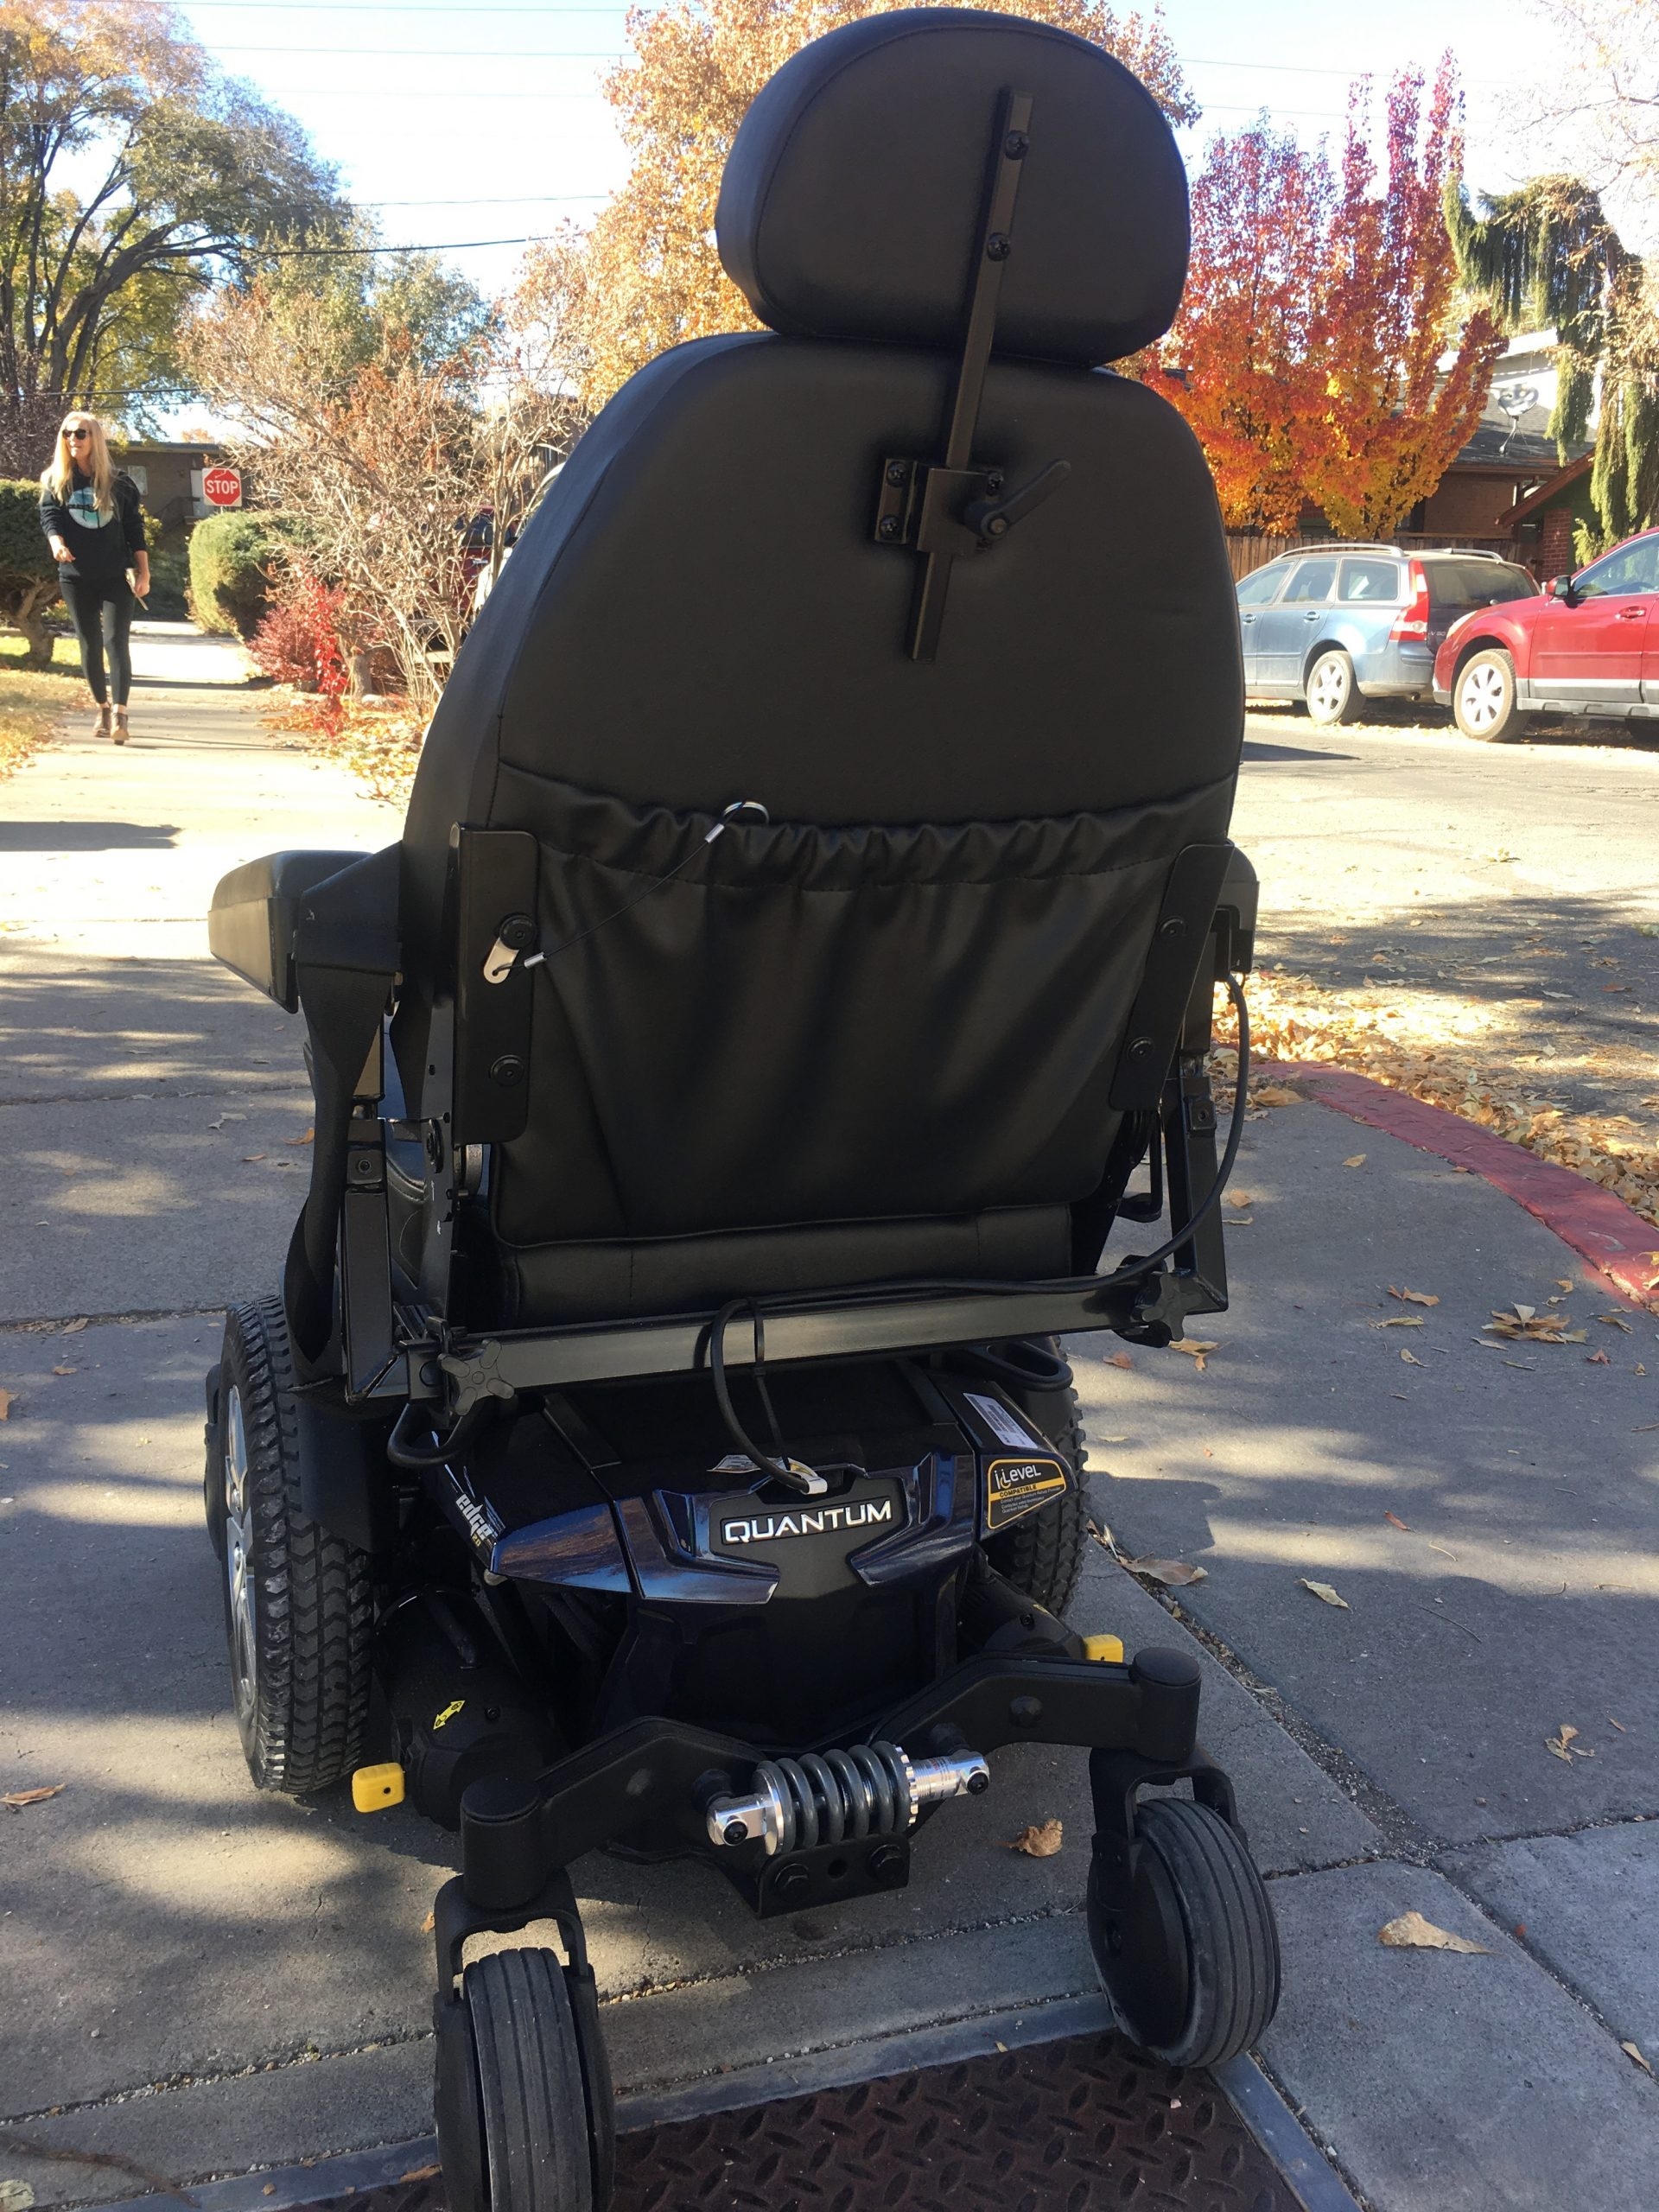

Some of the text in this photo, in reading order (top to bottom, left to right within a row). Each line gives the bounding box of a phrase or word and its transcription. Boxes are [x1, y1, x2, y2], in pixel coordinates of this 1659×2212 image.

[207, 480, 238, 494] STOP
[1000, 1484, 1037, 1497] COMPATIBLE
[455, 1493, 493, 1541] edge
[724, 1500, 892, 1542] QUANTUM
